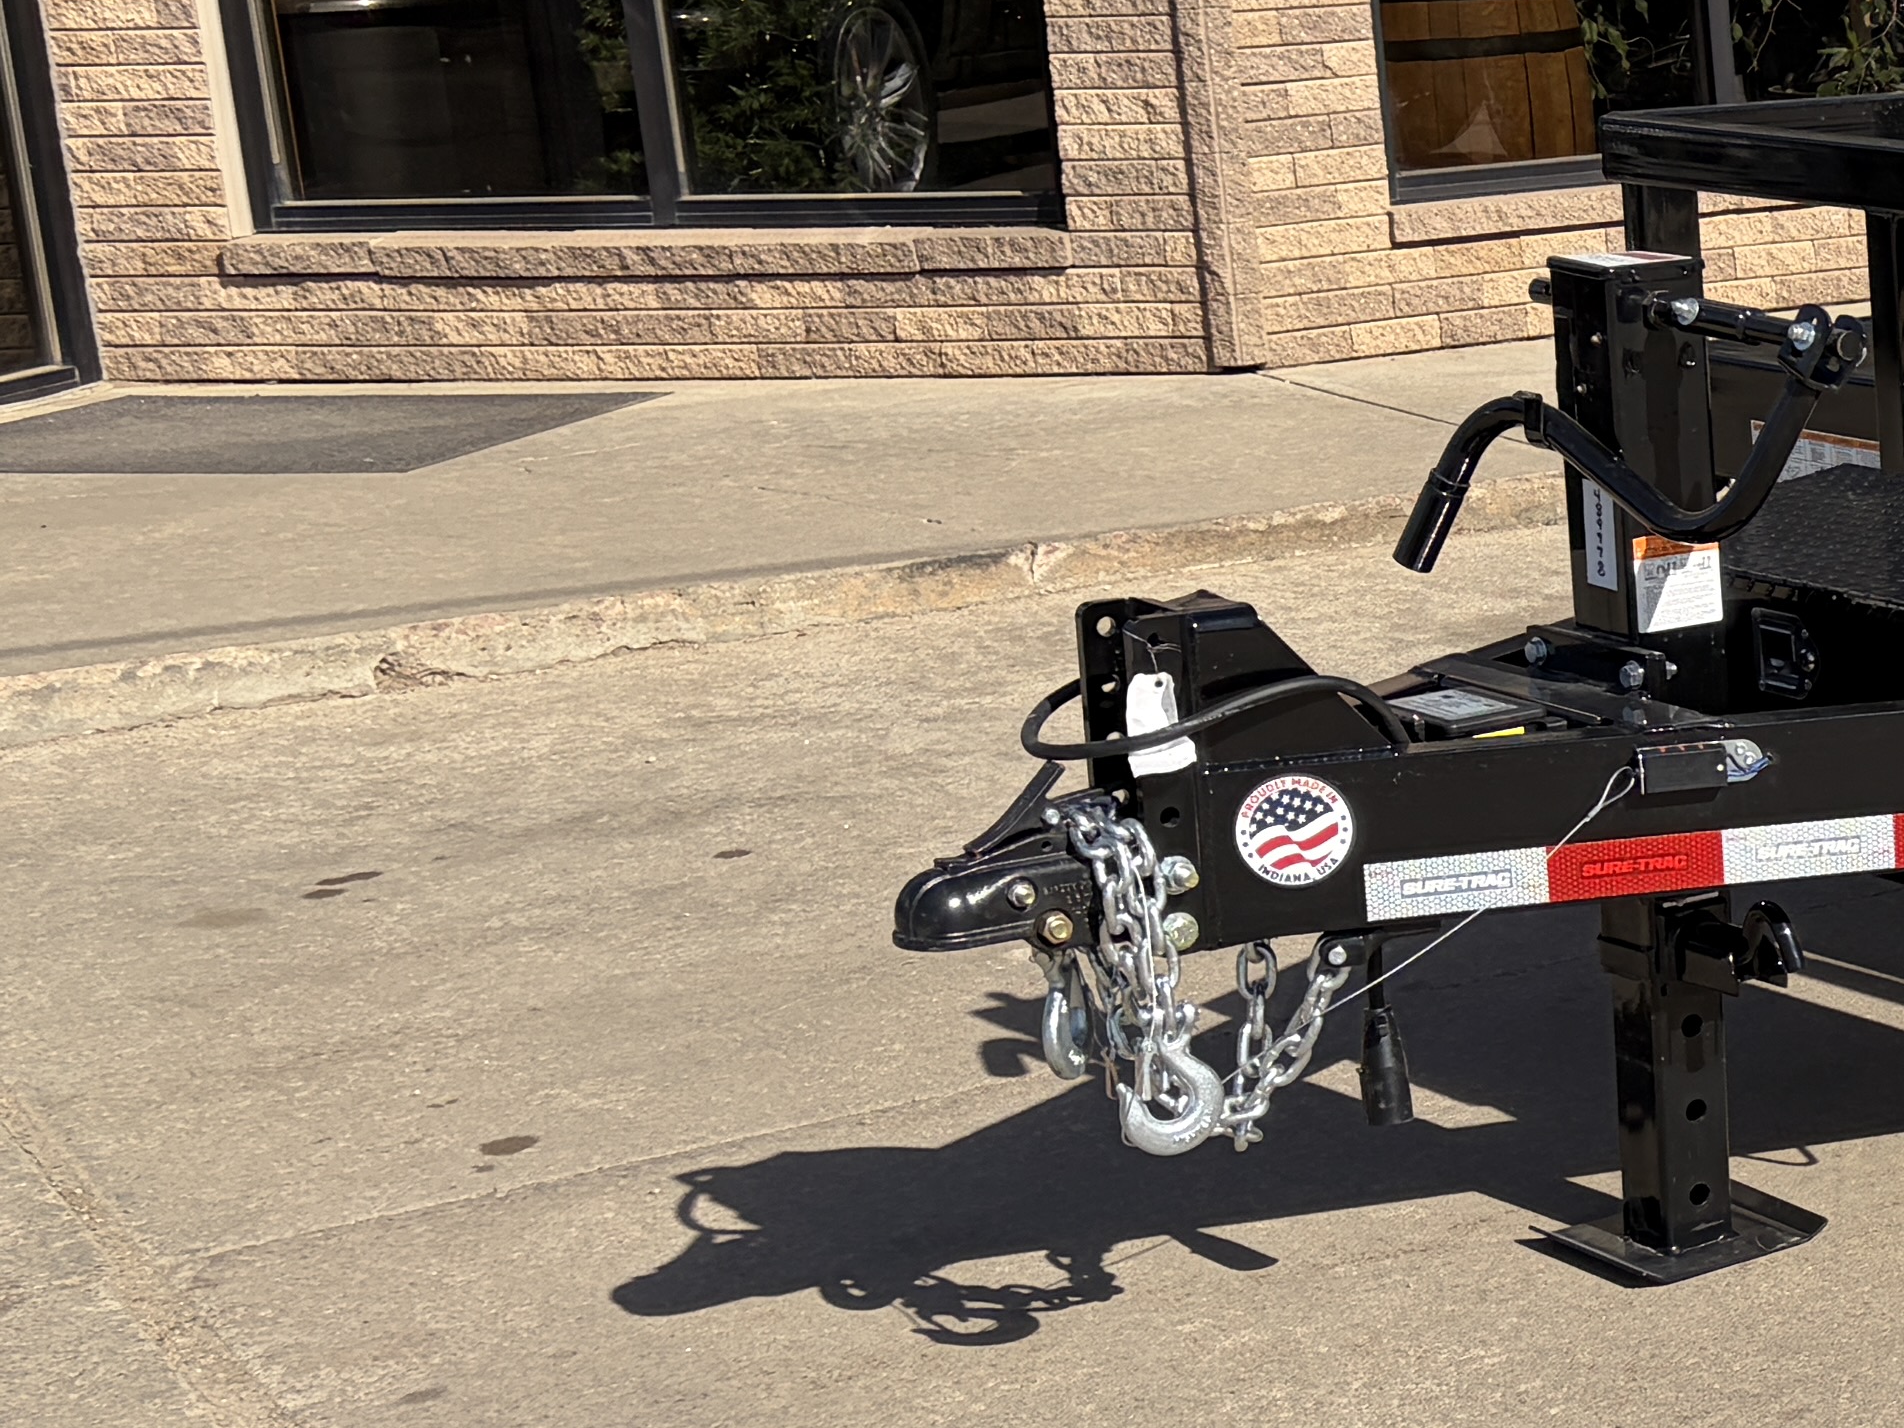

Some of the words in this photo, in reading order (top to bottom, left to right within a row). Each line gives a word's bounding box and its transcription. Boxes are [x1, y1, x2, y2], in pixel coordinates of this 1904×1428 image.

[1241, 779, 1287, 819] PROUDLY
[1291, 778, 1326, 794] MADE
[1325, 791, 1339, 804] IN
[1316, 858, 1339, 876] USA
[1582, 855, 1687, 877] SURE-TRAC
[1402, 872, 1511, 896] SURE-TRAC
